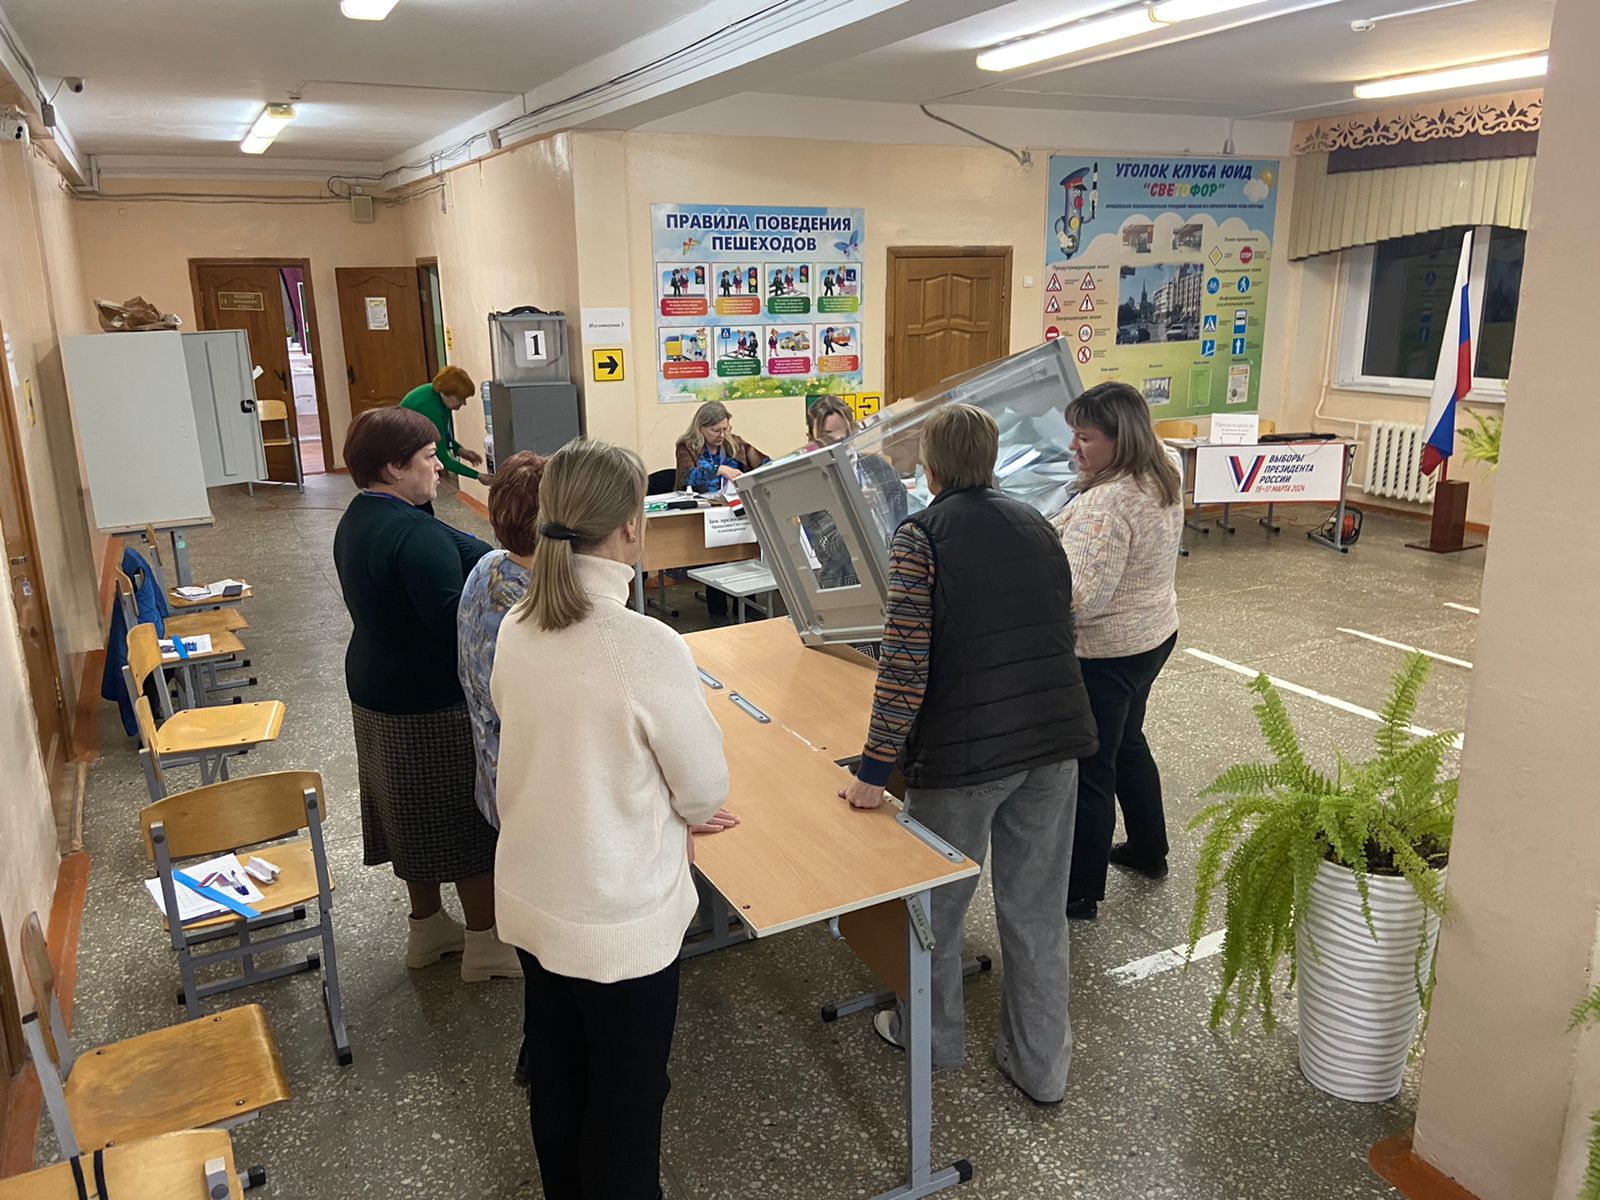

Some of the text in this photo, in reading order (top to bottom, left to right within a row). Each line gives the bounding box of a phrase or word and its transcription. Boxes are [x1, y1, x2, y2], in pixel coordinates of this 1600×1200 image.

[1115, 162, 1253, 181] УГОЛОК КЛУБА ЮИД
[666, 213, 851, 233] ПРАВИЛА ПОВЕДЕНИЯ
[711, 235, 817, 253] ПЕШЕХОДОВ
[529, 334, 542, 355] 1
[1269, 454, 1305, 463] ВЫБОРЫ
[1264, 464, 1314, 474] ПРЕЗИДЕНТА
[1259, 475, 1292, 484] РОССИИ
[1271, 485, 1291, 493] МАРТА
